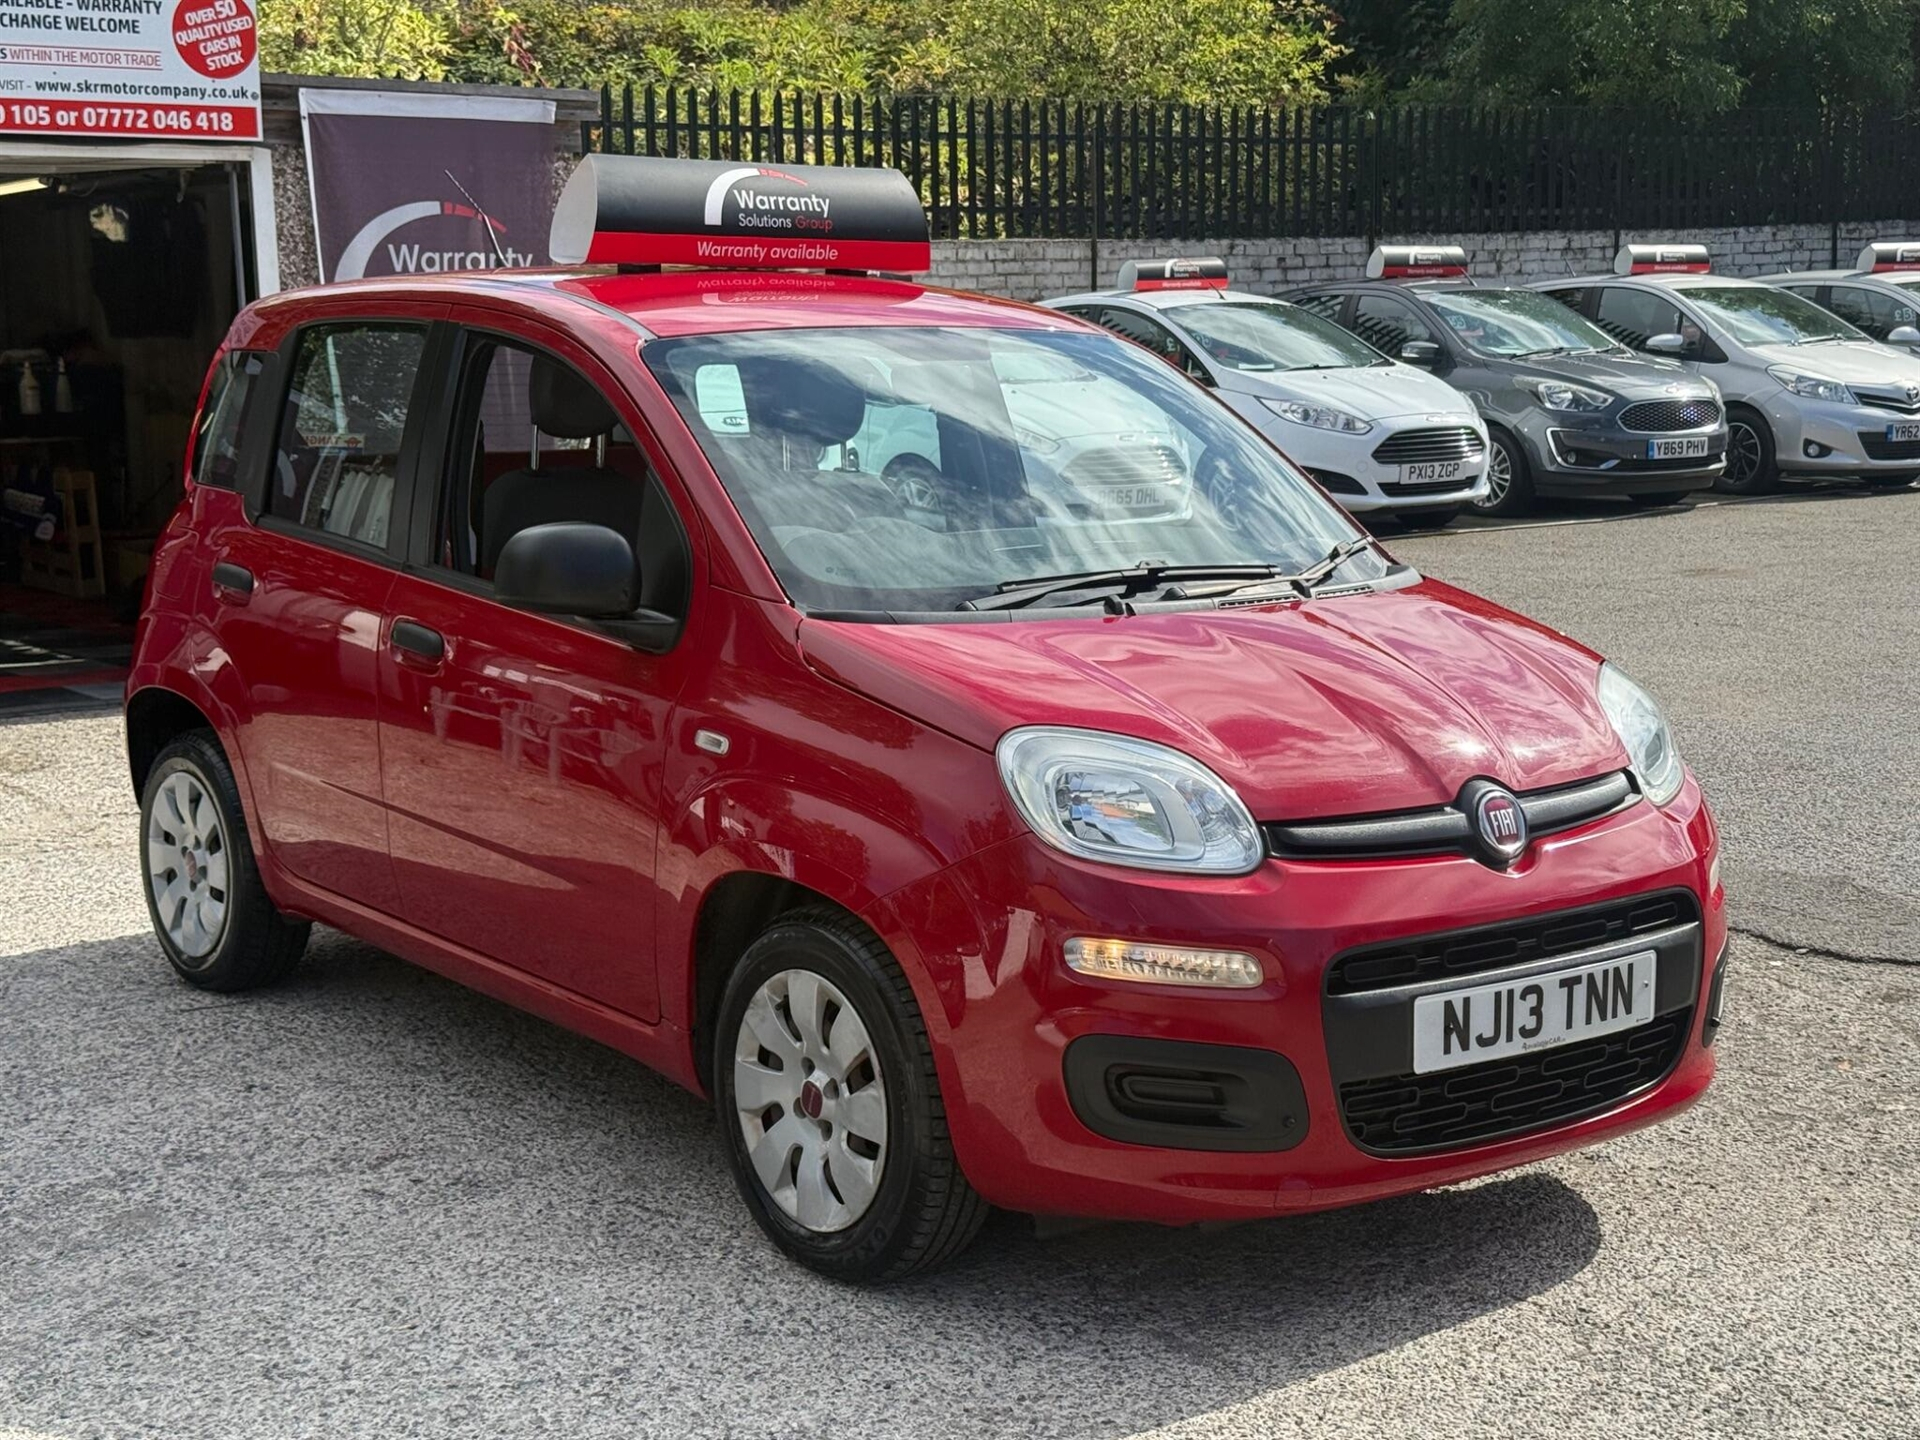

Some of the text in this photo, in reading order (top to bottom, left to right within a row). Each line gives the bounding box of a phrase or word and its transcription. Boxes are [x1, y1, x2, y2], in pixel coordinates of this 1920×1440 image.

[77, 0, 162, 15] WARRANTY
[185, 0, 237, 26] OVER 50
[0, 12, 141, 34] CHANGE WELCOME
[175, 15, 253, 46] QUALITY USED
[199, 34, 242, 56] CARS IN
[9, 48, 52, 61] WITHIN
[54, 50, 78, 63] THE
[80, 51, 122, 65] MOTOR
[124, 53, 162, 67] TRADE
[206, 51, 244, 71] STOCK
[0, 79, 24, 91] VISIT
[35, 79, 249, 100] www.skrmotorcompany.co.uk
[11, 104, 51, 126] 105
[56, 110, 79, 127] or
[83, 107, 149, 129] 07772
[153, 109, 192, 131] 046
[196, 111, 234, 132] 418
[733, 189, 830, 218] Warranty
[738, 212, 833, 233] Solutions Group
[697, 241, 838, 262] Warranty available
[1894, 424, 1920, 439] YR62
[1656, 439, 1706, 456] YB69 PHV
[1408, 462, 1460, 480] PX13 ZGP
[1489, 808, 1517, 838] FIAT
[1443, 962, 1634, 1056] NJ13 TNN
